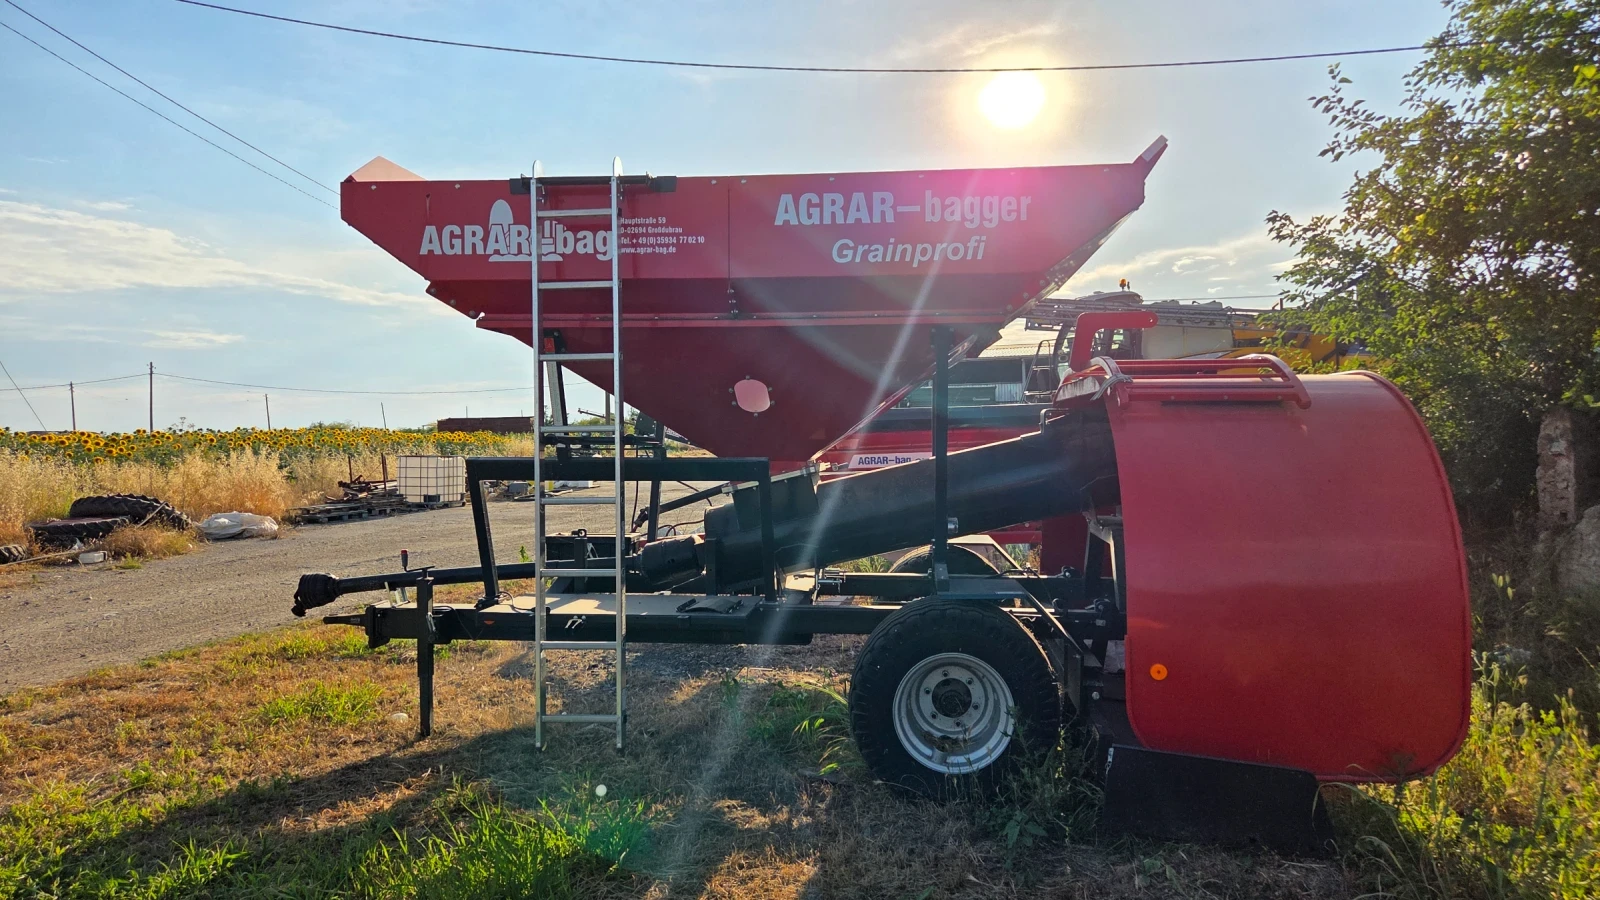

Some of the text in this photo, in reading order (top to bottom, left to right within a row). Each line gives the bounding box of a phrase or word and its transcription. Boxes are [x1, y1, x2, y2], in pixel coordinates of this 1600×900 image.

[774, 190, 1032, 229] AGRAR-bagger
[620, 216, 667, 225] Hauptstraße 59
[647, 226, 683, 234] Großdubrau
[621, 237, 632, 245] Tel.
[620, 245, 677, 254] www.agrar-bag.de
[831, 236, 987, 267] Grainprofi
